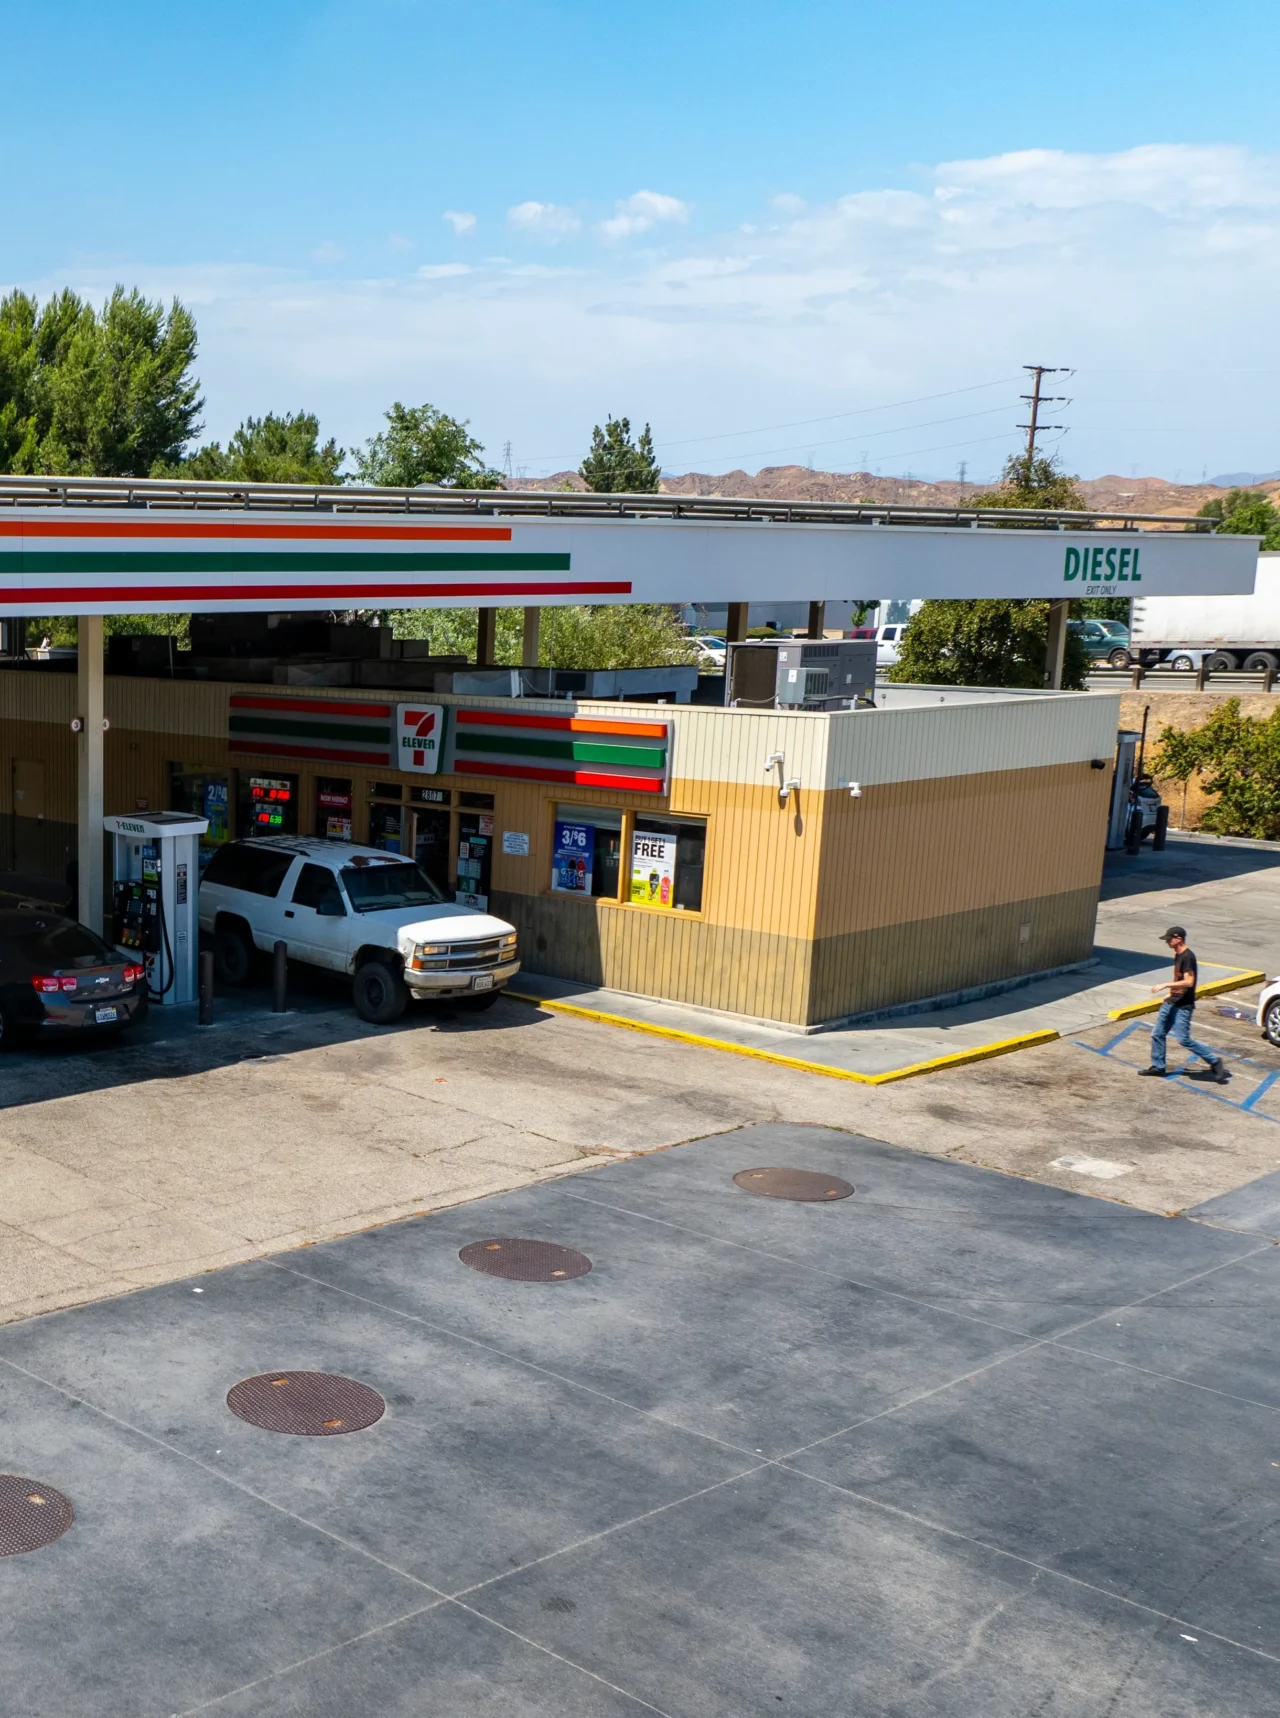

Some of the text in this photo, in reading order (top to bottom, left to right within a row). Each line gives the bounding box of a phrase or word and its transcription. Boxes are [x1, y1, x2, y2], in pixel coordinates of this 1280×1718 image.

[1063, 547, 1142, 581] DIESEL
[1086, 585, 1117, 595] EXIT ONLY
[320, 794, 331, 802] NOW
[422, 790, 439, 800] 2807
[562, 830, 587, 847] 3/$6
[634, 842, 665, 859] FREE
[461, 881, 468, 890] A
